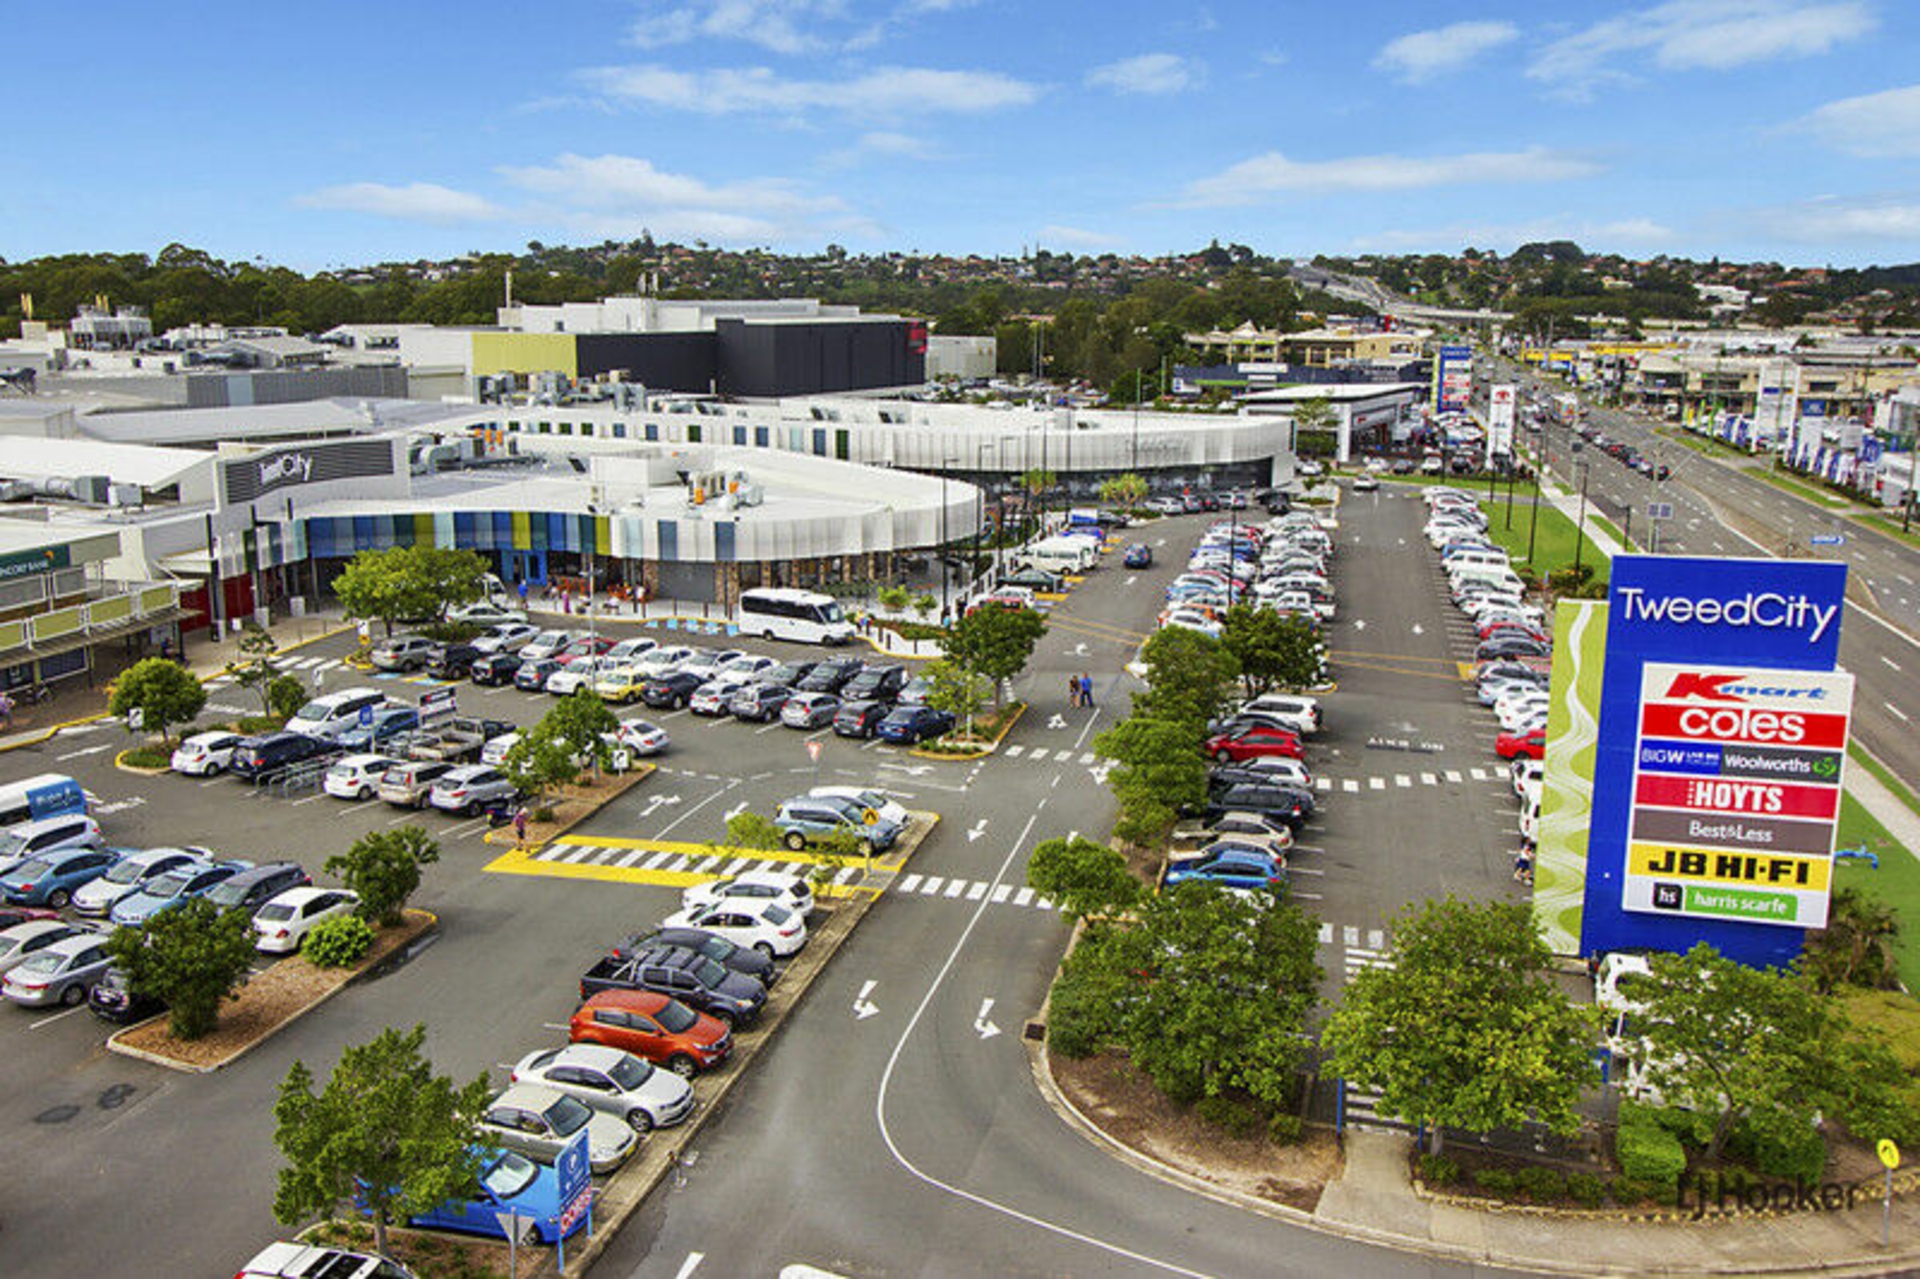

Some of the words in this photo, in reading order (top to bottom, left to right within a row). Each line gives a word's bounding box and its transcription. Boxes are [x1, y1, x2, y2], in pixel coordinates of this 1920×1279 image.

[1617, 587, 1837, 643] TweedCity
[1664, 672, 1830, 703] Kmart
[1679, 708, 1806, 742] coles
[1725, 754, 1811, 774] Woolworths
[1694, 780, 1783, 812] HOYTS
[1648, 850, 1707, 876] JB
[1659, 885, 1677, 904] hs
[1693, 891, 1738, 910] harris
[1741, 896, 1788, 915] scarfe
